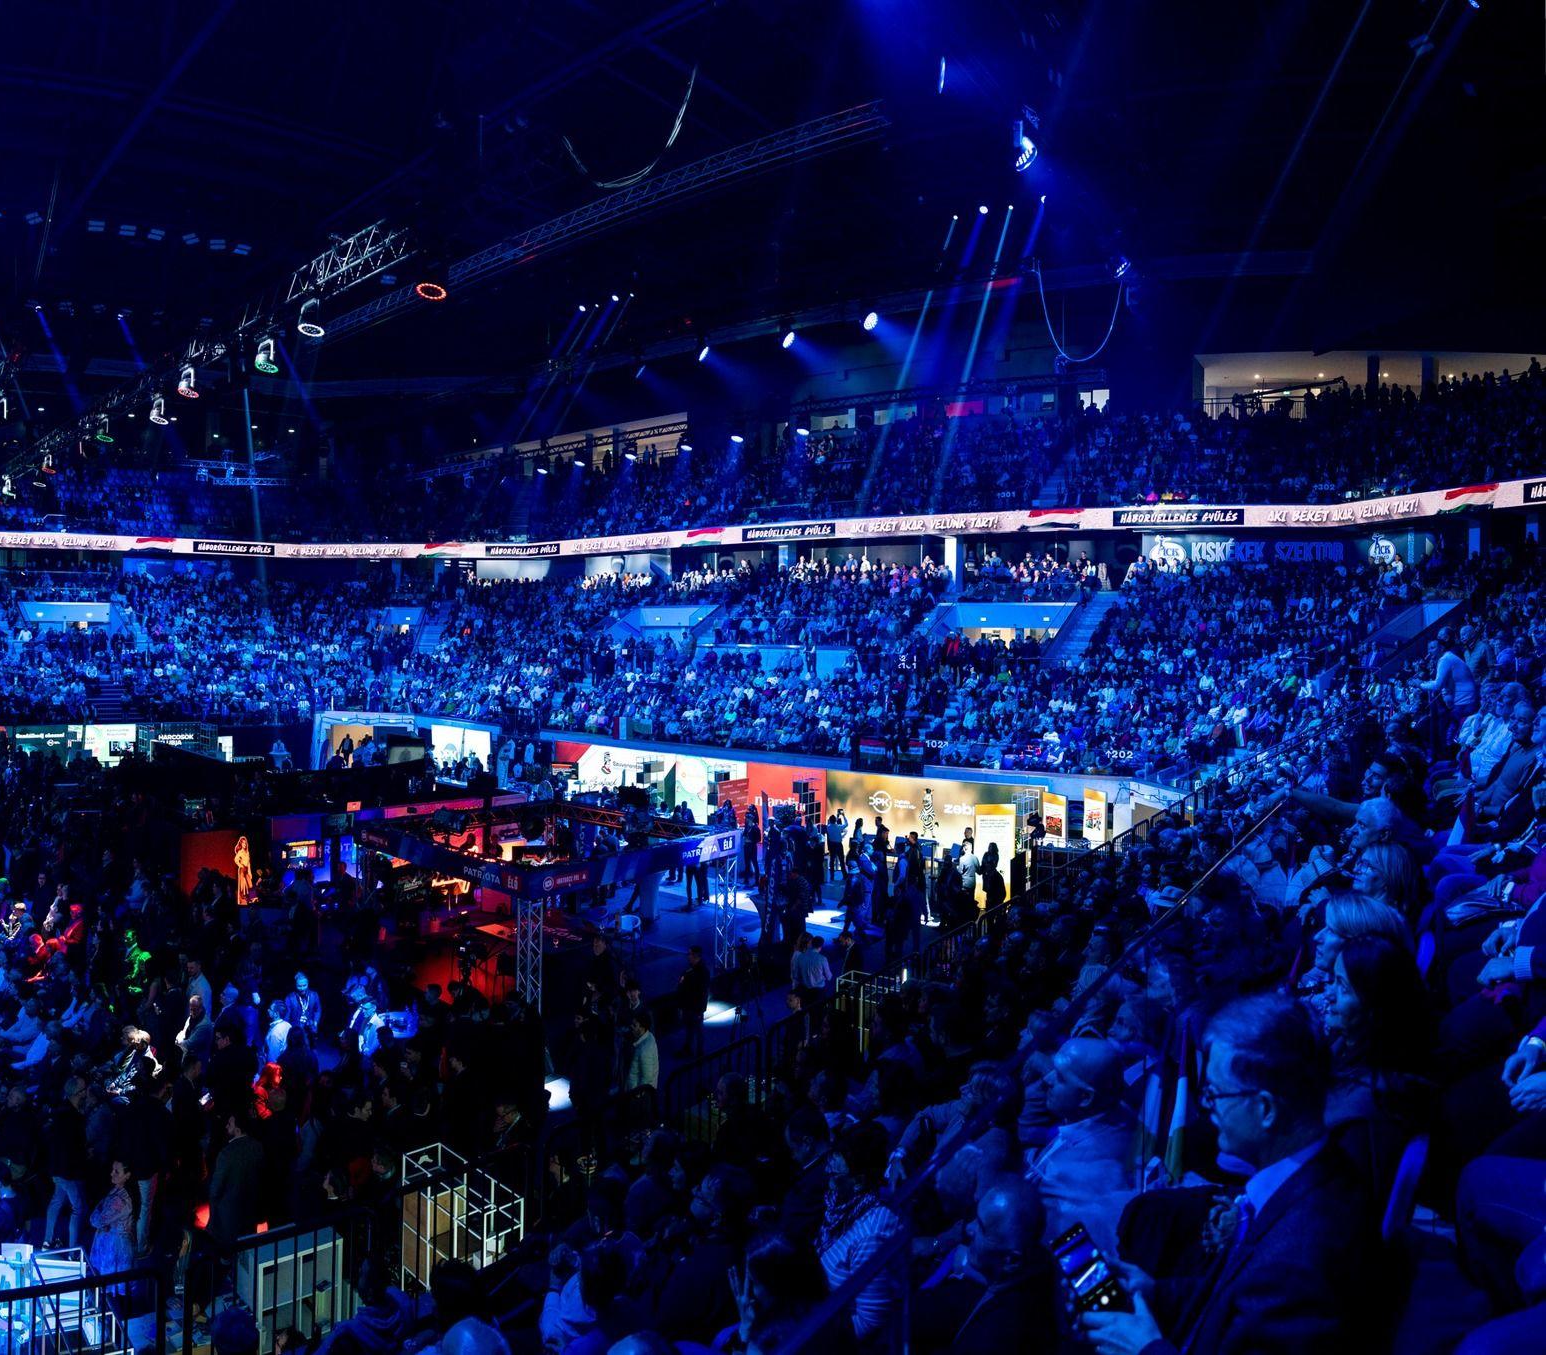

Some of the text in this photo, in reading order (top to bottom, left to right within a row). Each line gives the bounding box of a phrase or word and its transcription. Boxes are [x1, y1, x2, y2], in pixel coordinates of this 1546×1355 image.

[1120, 511, 1198, 523] HÁBORÚELLENES
[1268, 511, 1288, 522] AKI
[1291, 508, 1329, 521] BÉKÉT
[1332, 509, 1355, 521] AKAR,
[1394, 498, 1419, 514] TART!
[852, 521, 865, 533] AKI
[869, 519, 896, 532] BÉKÉT
[899, 520, 926, 532] AKAR,
[970, 516, 999, 530] TART!
[1191, 539, 1267, 562] KISKÉKEK
[926, 740, 944, 748] 102
[1112, 750, 1134, 759] 202
